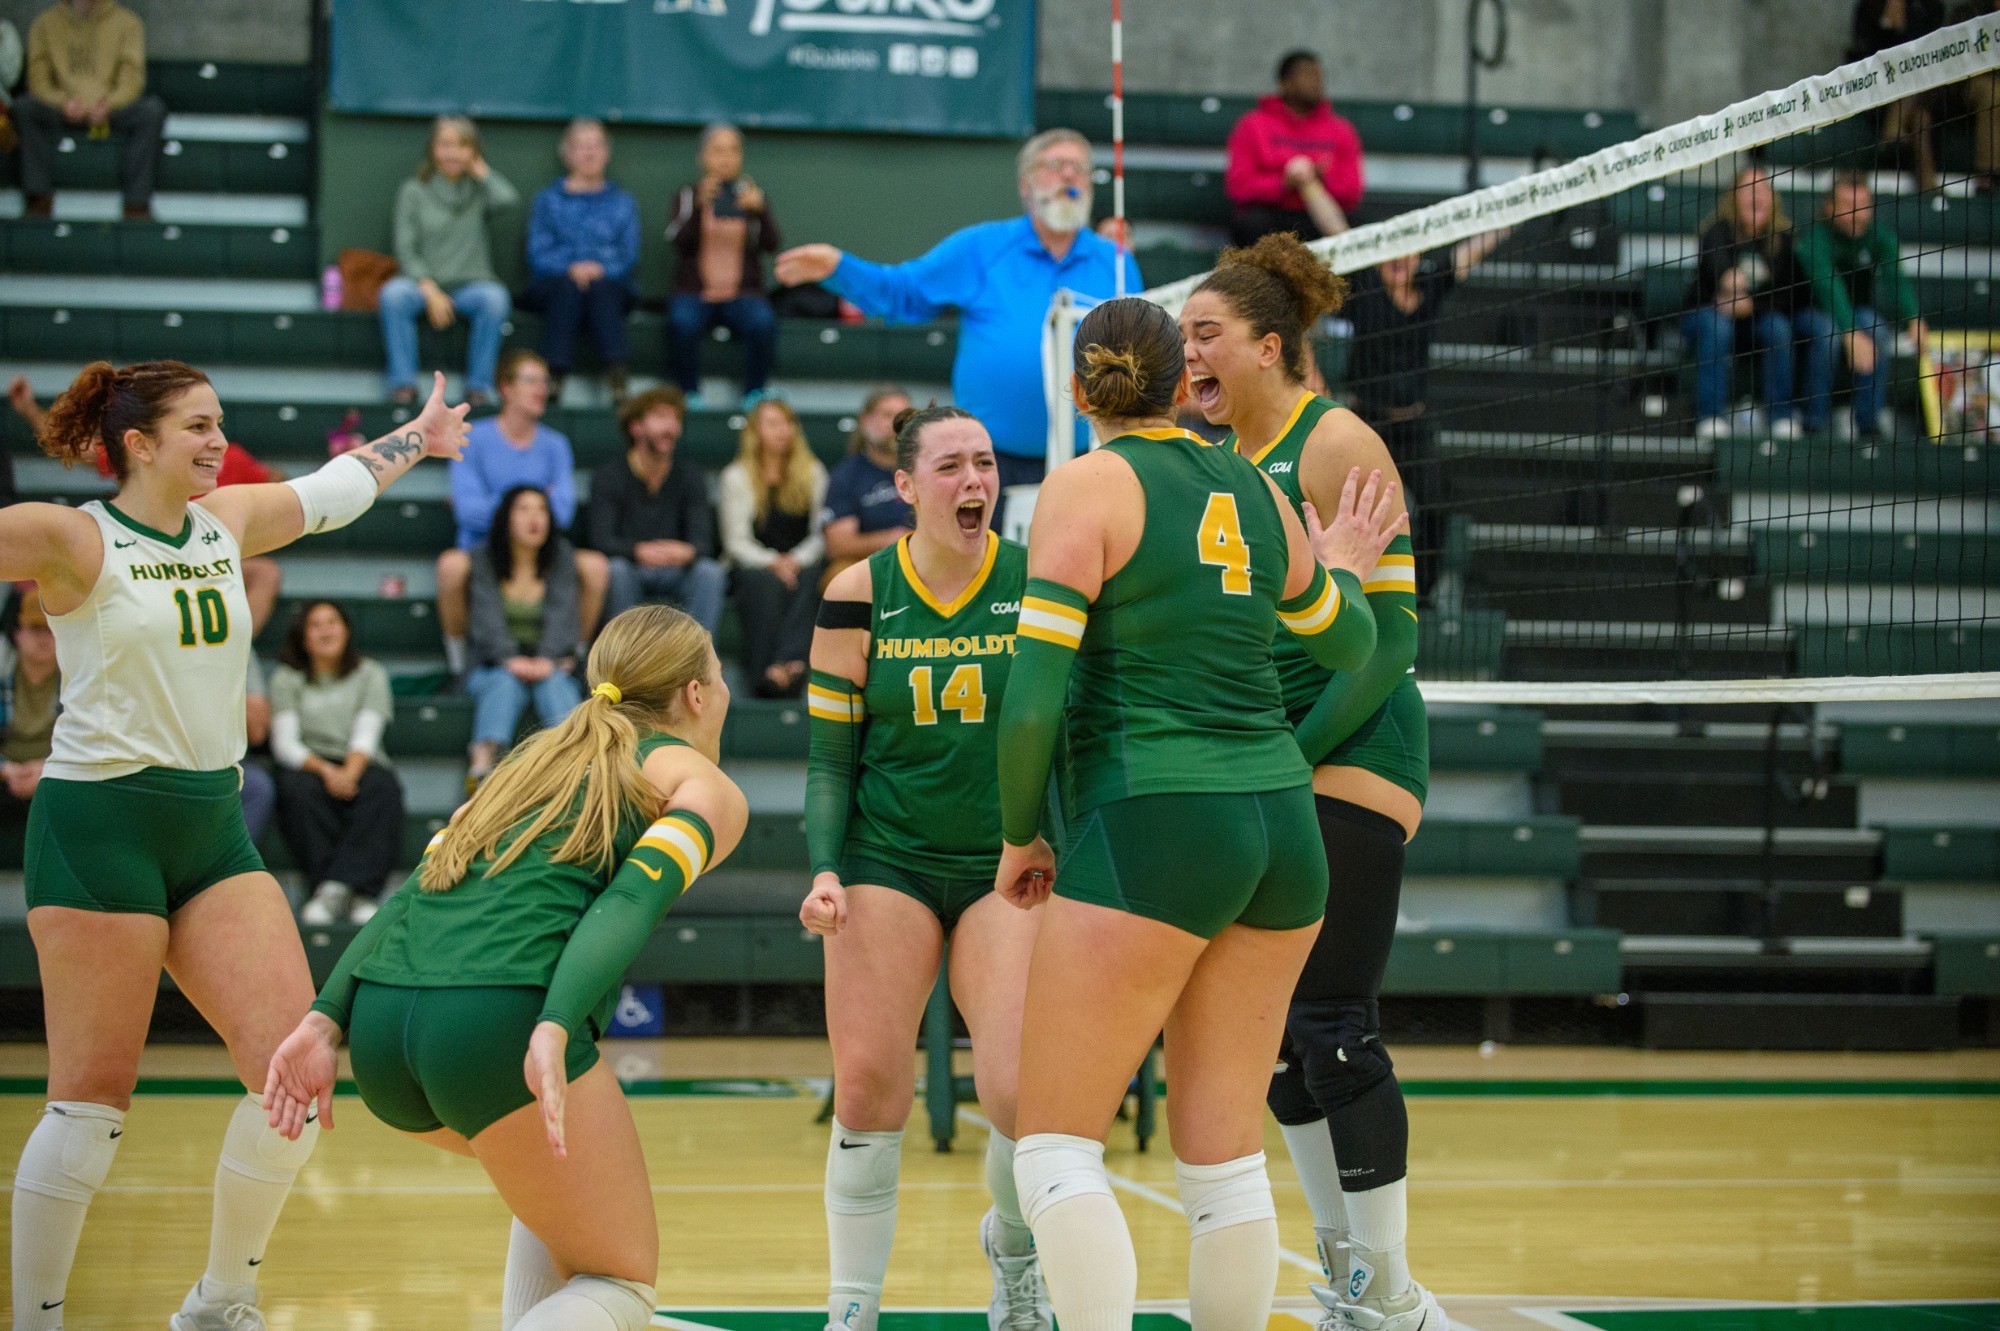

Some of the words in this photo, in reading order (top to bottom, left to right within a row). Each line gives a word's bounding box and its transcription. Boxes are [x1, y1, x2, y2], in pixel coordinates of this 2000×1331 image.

[1269, 461, 1293, 473] CCAA
[1197, 492, 1252, 596] 4
[172, 586, 231, 648] 10
[991, 601, 1020, 615] CCAA
[877, 634, 1017, 659] HUMBOLDT
[908, 663, 987, 726] 14
